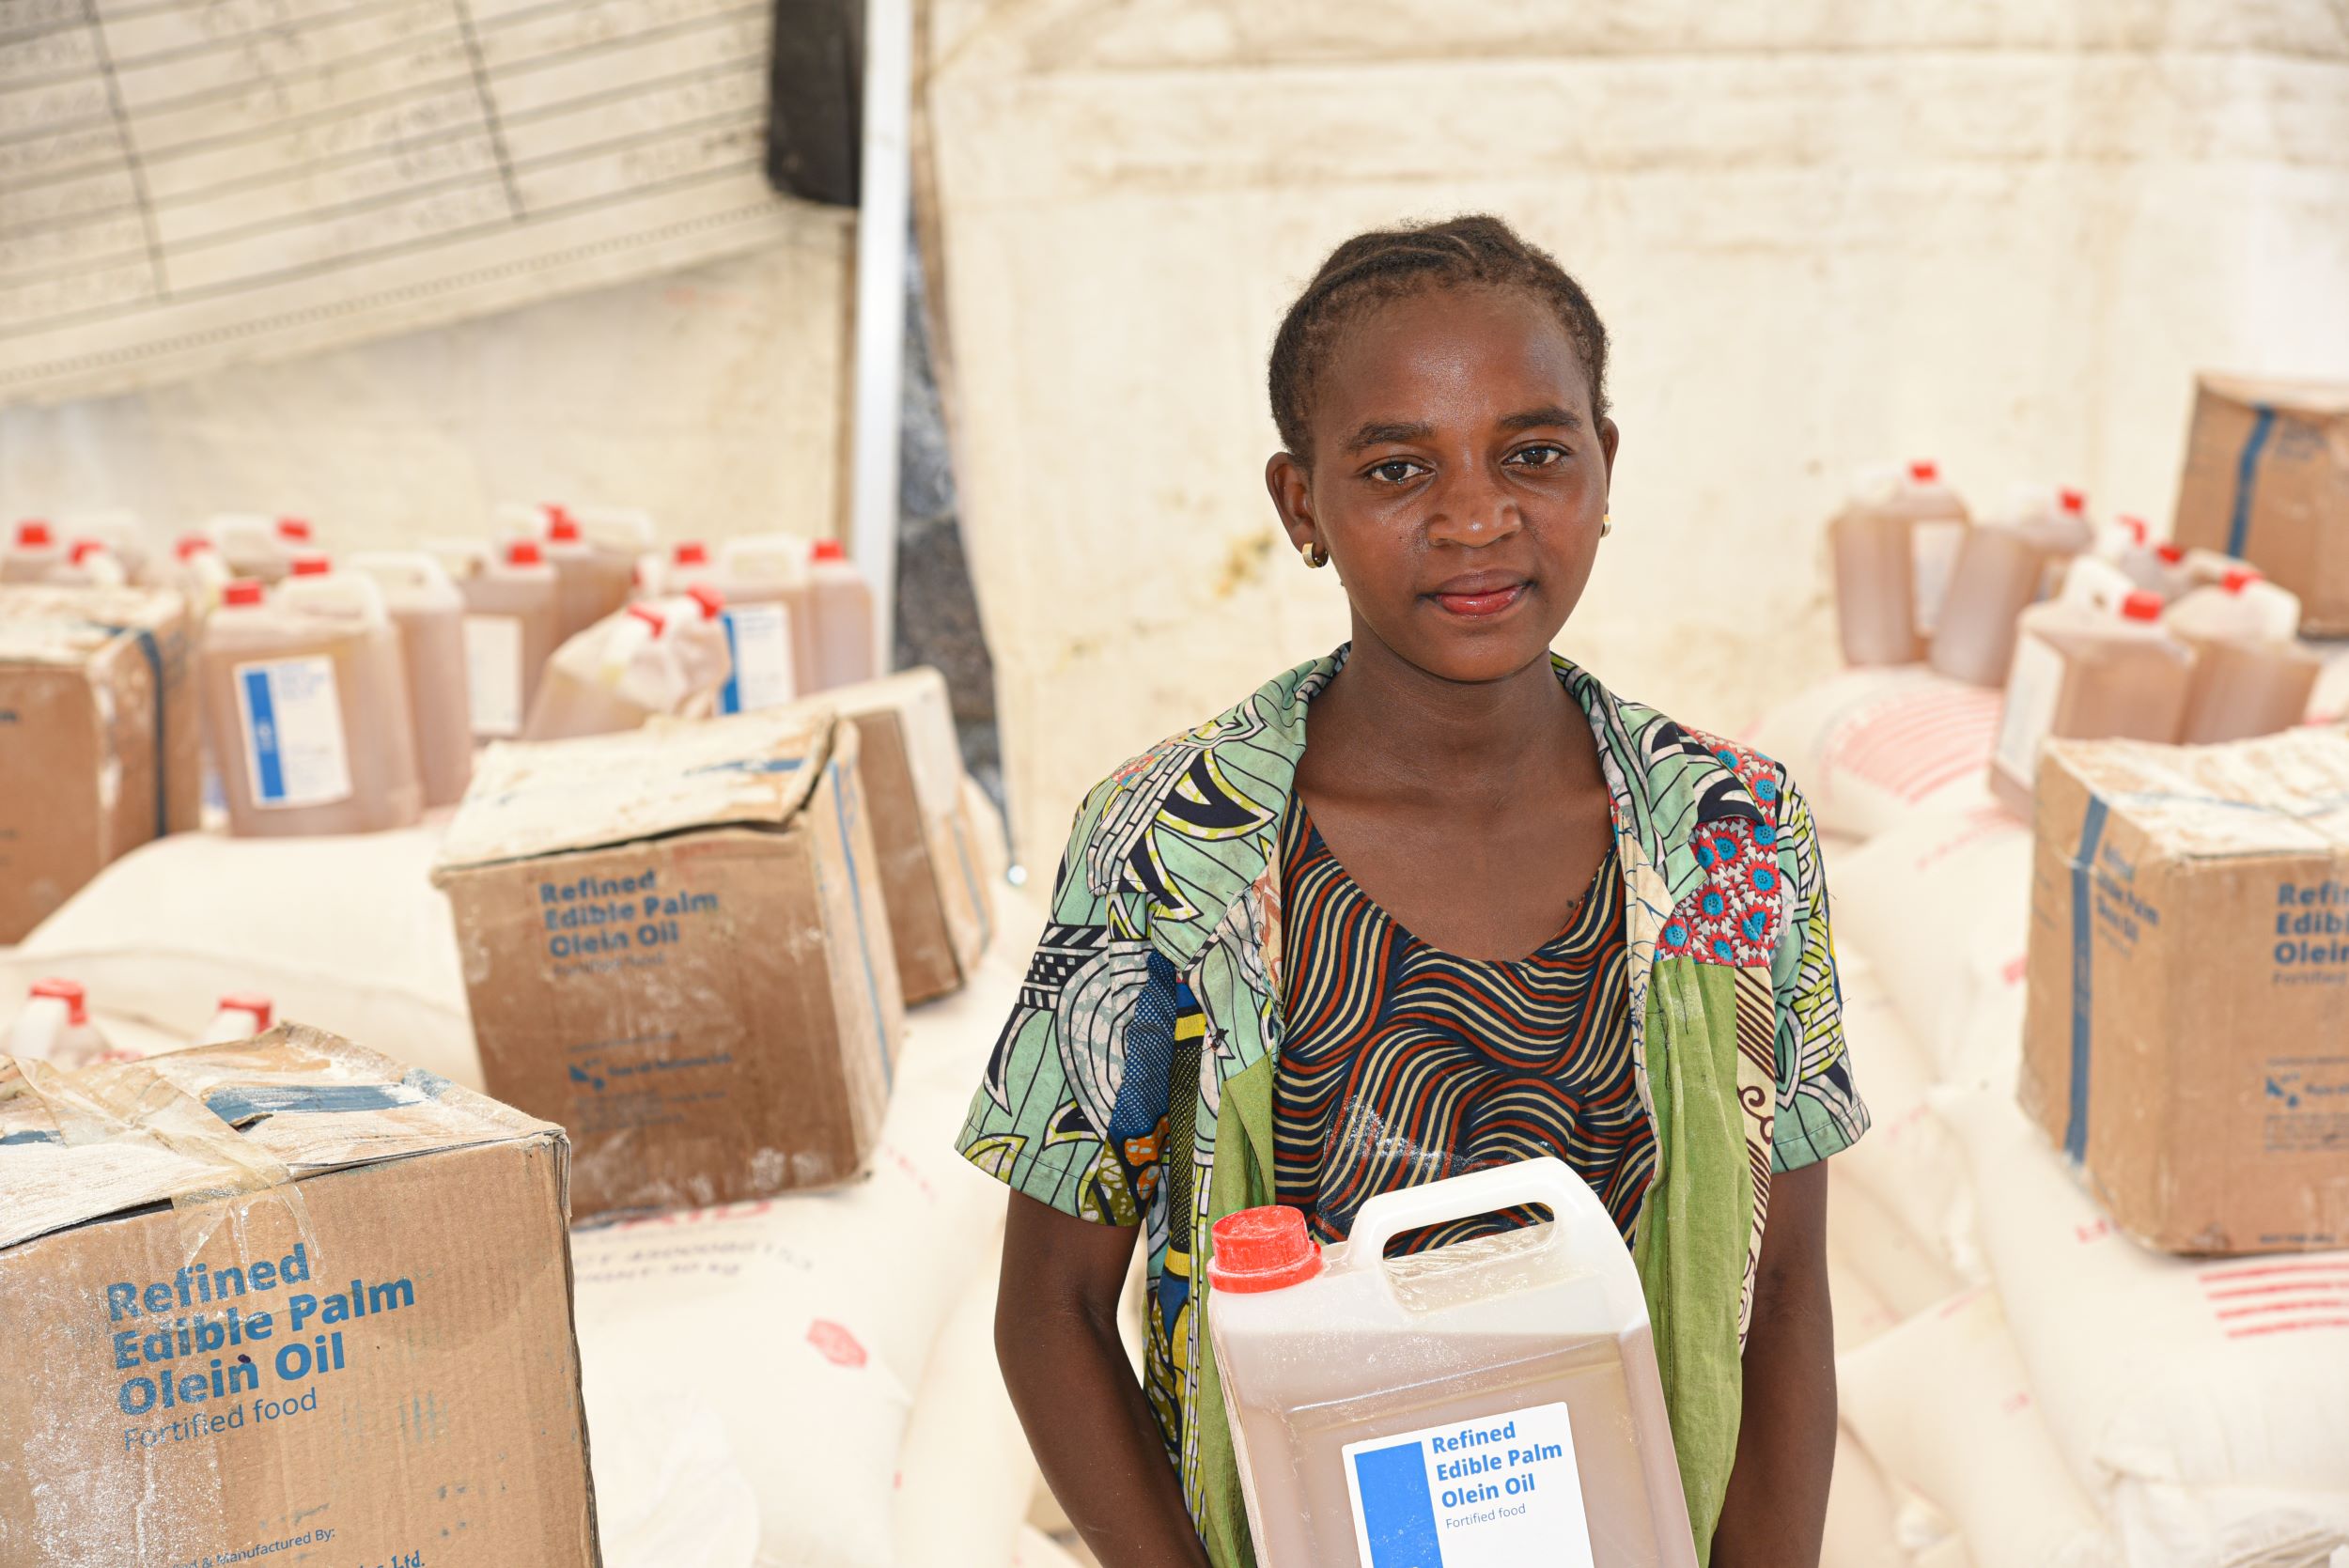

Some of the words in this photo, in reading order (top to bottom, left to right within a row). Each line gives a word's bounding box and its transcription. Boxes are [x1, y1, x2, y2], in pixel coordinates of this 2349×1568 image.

[540, 869, 656, 904] Refined
[2279, 881, 2349, 906] Refi
[545, 902, 635, 931] Edible
[644, 891, 719, 918] Palm
[550, 930, 630, 958] Olein
[637, 920, 679, 947] Oil
[106, 1242, 311, 1322] Refined
[114, 1307, 273, 1370] Edible
[289, 1277, 414, 1332] Palm
[118, 1358, 259, 1416] Olein
[275, 1331, 345, 1381] Oil
[123, 1405, 244, 1452] Fortified
[254, 1387, 318, 1423] food
[1432, 1421, 1517, 1454] Refined
[1437, 1454, 1502, 1482] Edible
[1508, 1443, 1563, 1467] Palm
[1441, 1483, 1500, 1508] Olein
[1505, 1473, 1535, 1496] Oil
[1446, 1509, 1496, 1529] Fortified
[1499, 1503, 1526, 1518] food
[216, 1532, 311, 1566] Manufactured
[316, 1528, 335, 1543] By:
